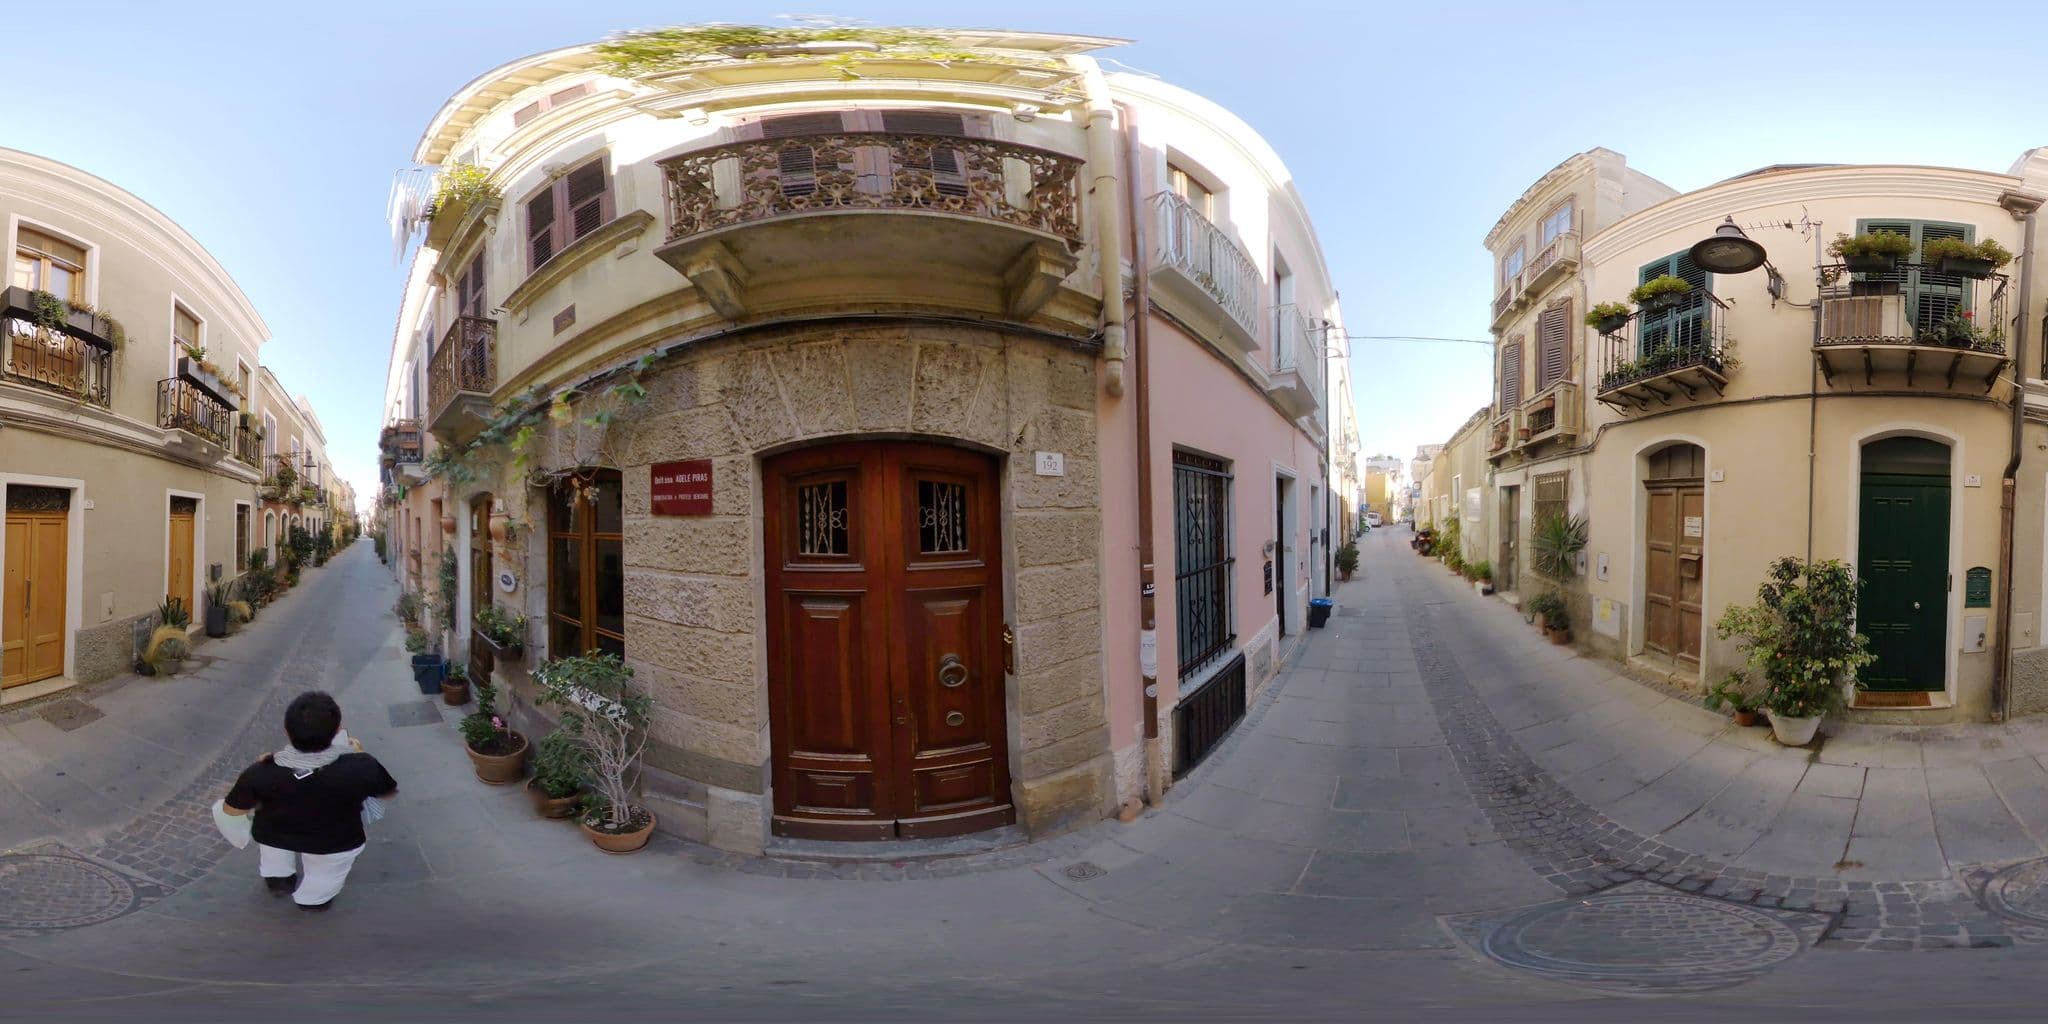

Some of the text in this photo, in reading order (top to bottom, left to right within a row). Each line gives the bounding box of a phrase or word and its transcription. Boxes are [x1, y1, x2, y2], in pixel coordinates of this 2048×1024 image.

[1042, 460, 1057, 470] 192
[675, 474, 690, 482] ADELE
[692, 473, 707, 482] PIRAS
